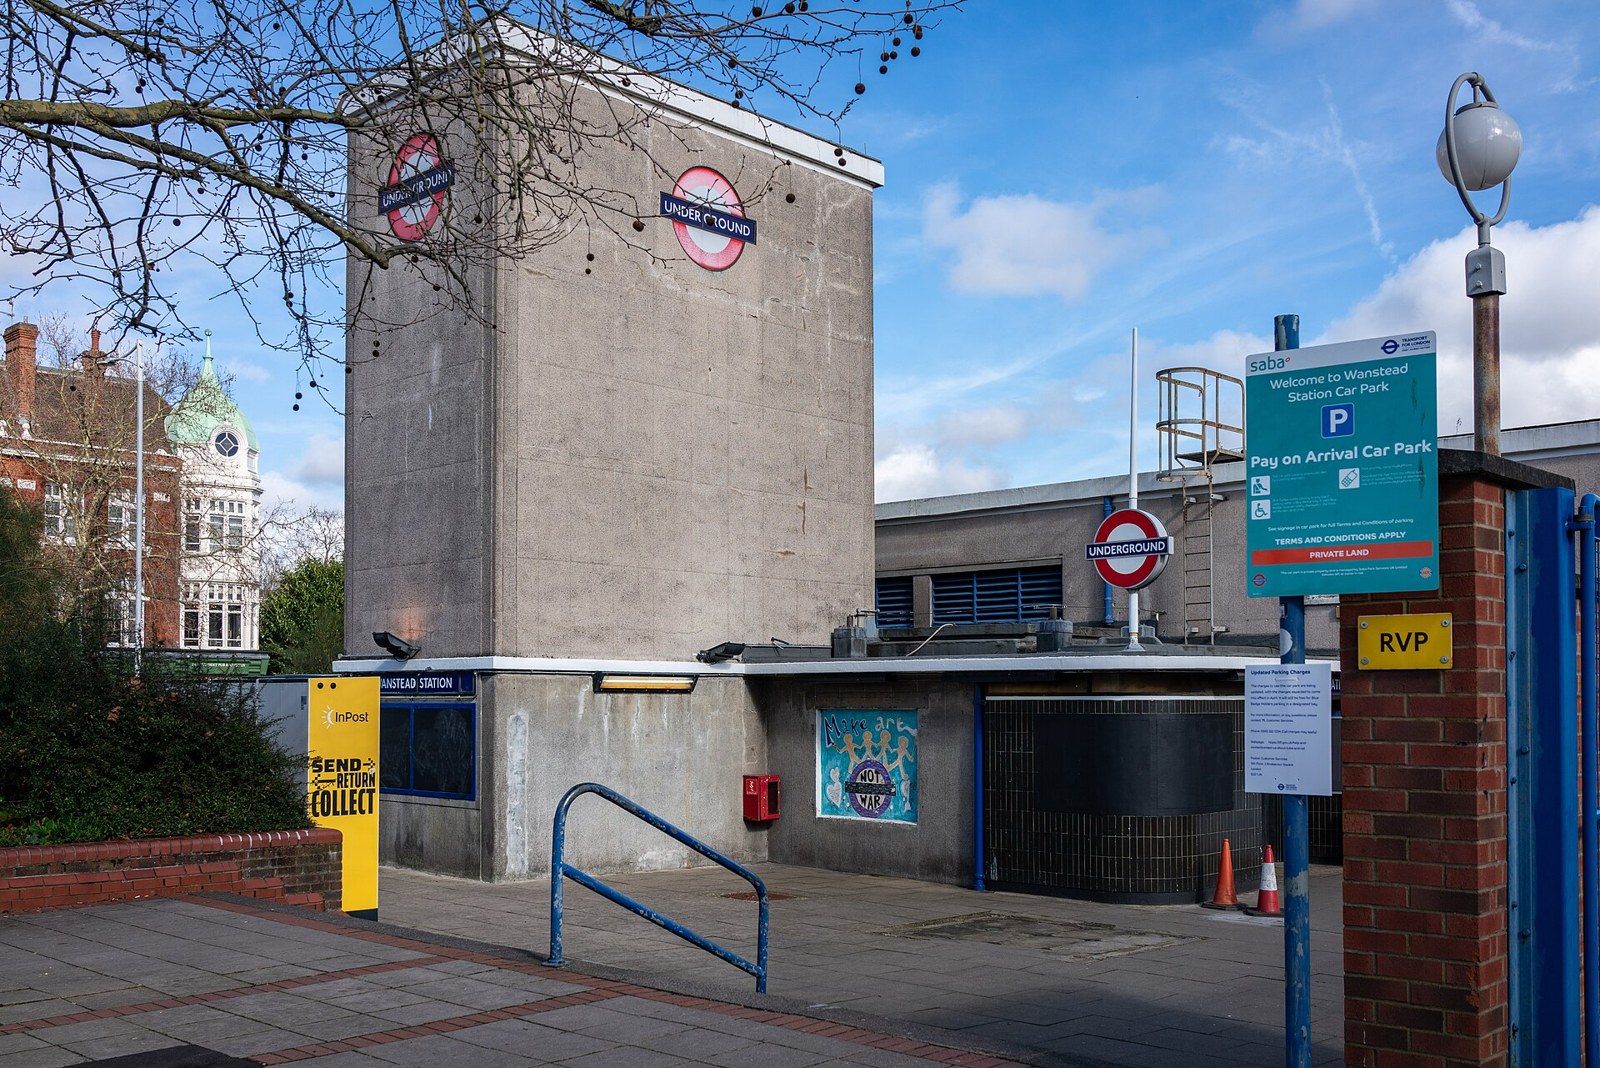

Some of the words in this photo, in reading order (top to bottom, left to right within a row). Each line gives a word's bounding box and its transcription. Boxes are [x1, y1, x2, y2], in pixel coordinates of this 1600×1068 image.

[1250, 356, 1285, 372] saba
[1270, 375, 1325, 390] Welcome
[1328, 372, 1341, 382] to
[1344, 363, 1409, 380] Wanstead
[1288, 389, 1332, 403] Station
[1335, 386, 1357, 397] Car
[1360, 381, 1389, 394] Park
[1330, 409, 1348, 433] P
[1251, 455, 1278, 470] Pay
[1282, 454, 1301, 465] on
[1305, 446, 1358, 463] Arrival
[1362, 444, 1390, 458] Car
[1394, 440, 1432, 455] Park
[1324, 532, 1377, 543] CONDITIONS
[1089, 541, 1165, 556] UNDERGROUND
[1309, 550, 1344, 559] PRIVATE
[1346, 549, 1370, 557] LAND
[1380, 632, 1428, 652] RVP
[380, 678, 416, 689] ANSTEAD
[419, 677, 452, 688] STATION
[335, 712, 369, 722] InPost
[824, 714, 868, 748] Make
[875, 716, 917, 736] art
[312, 758, 361, 772] SEND
[337, 772, 375, 788] RETURN
[860, 769, 880, 783] NOT
[312, 789, 376, 817] COLLECT
[860, 795, 881, 810] WAR
